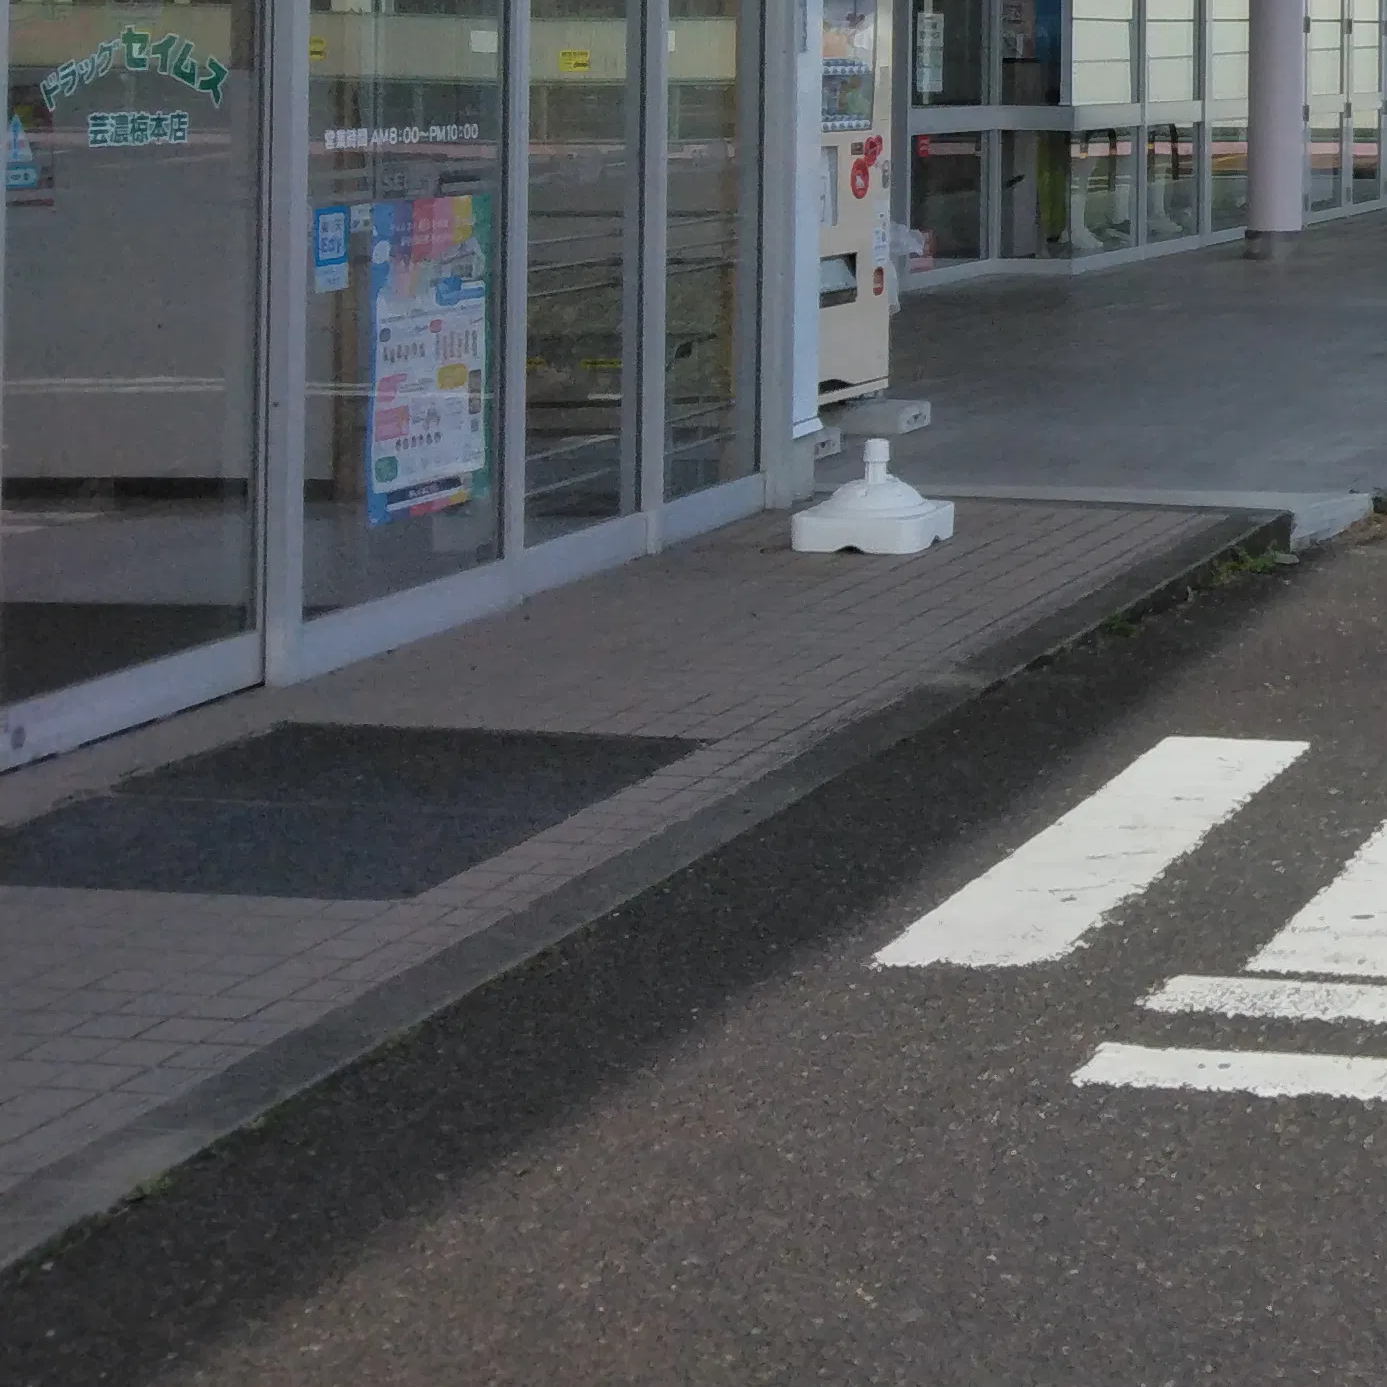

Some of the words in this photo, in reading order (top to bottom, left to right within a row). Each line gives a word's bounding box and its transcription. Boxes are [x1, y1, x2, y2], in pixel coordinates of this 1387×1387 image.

[87, 110, 191, 148] 芸濃椋本店
[324, 127, 368, 150] 営業時間
